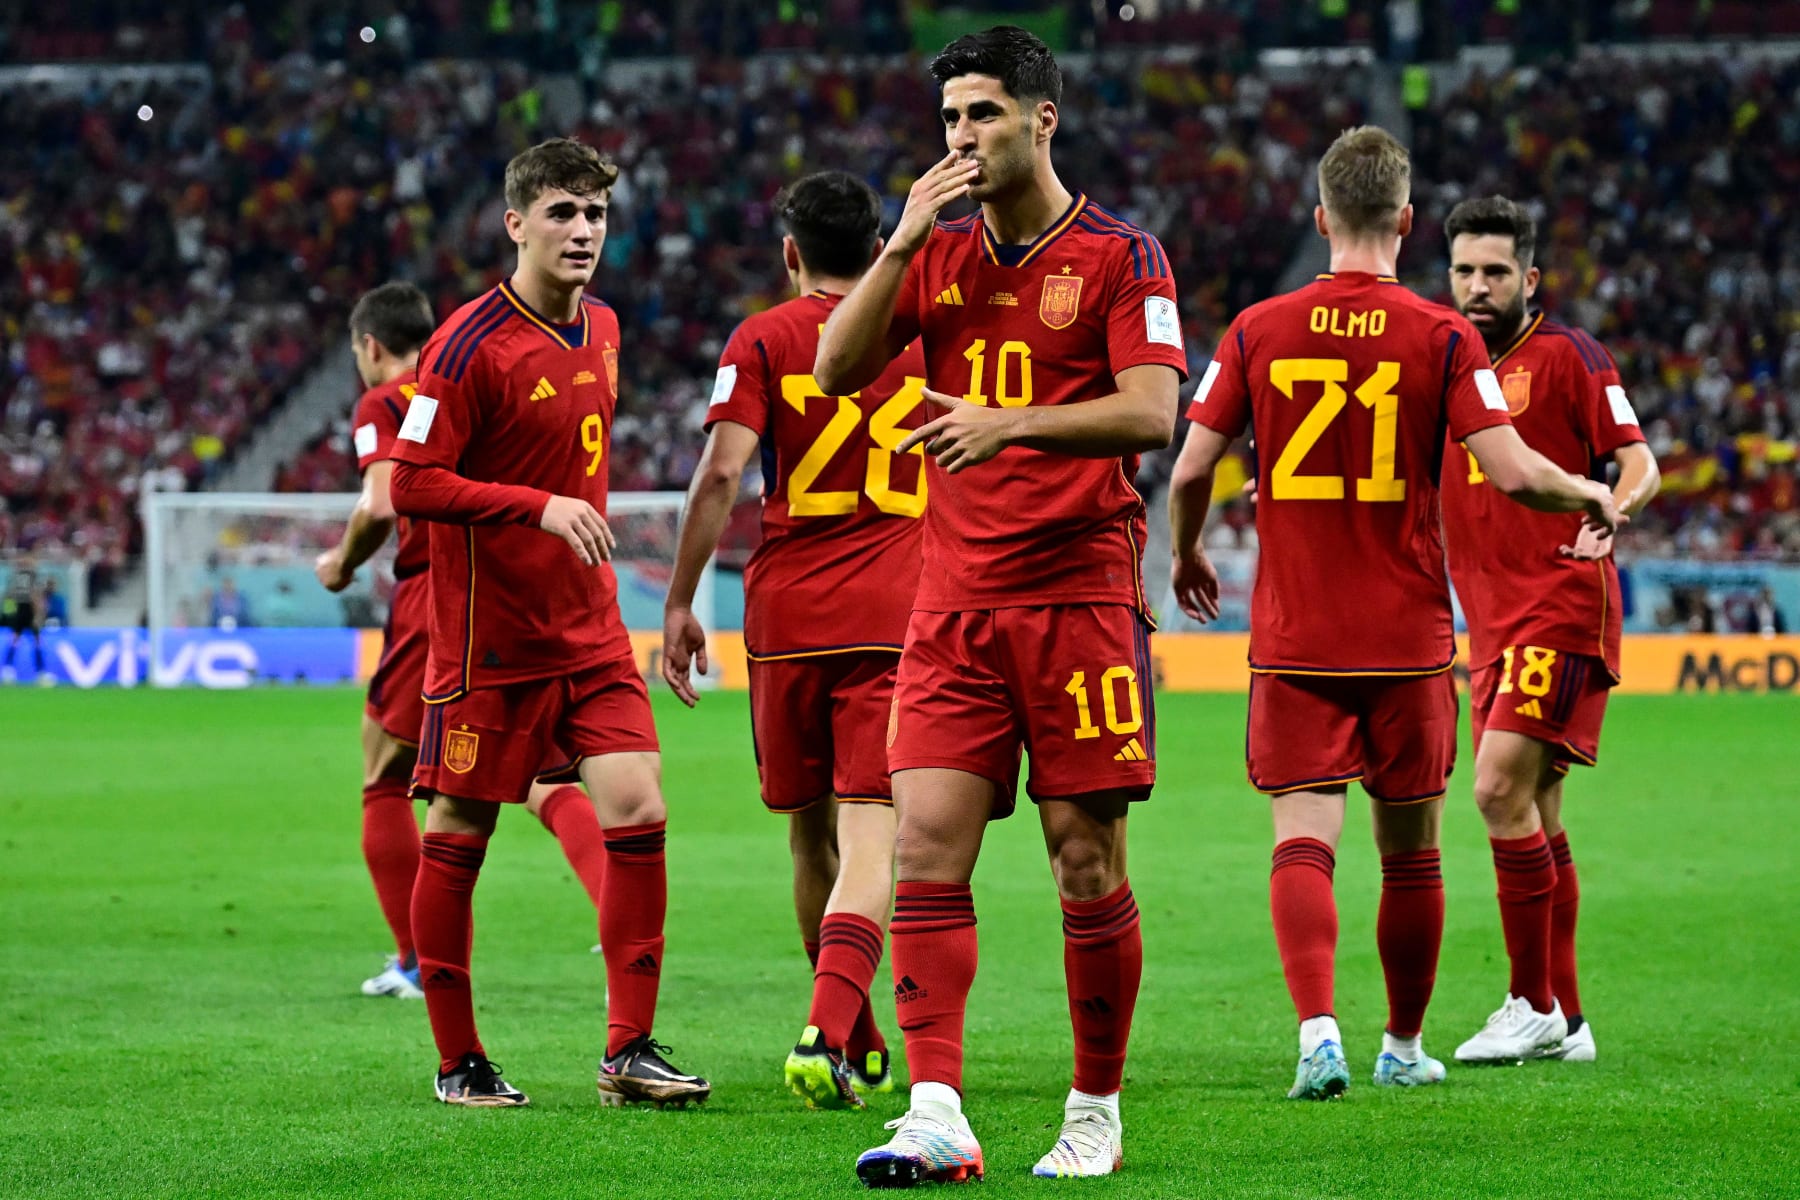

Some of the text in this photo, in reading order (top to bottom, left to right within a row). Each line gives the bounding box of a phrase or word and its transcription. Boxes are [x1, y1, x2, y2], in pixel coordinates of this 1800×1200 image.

[1310, 306, 1387, 338] OLMO
[962, 338, 1033, 408] 10
[581, 413, 602, 477] 9
[780, 374, 928, 518] 26
[1269, 358, 1406, 502] 21
[57, 630, 258, 688] vivo
[1497, 645, 1557, 697] 18
[1679, 652, 1800, 691] McD
[1064, 665, 1142, 739] 10
